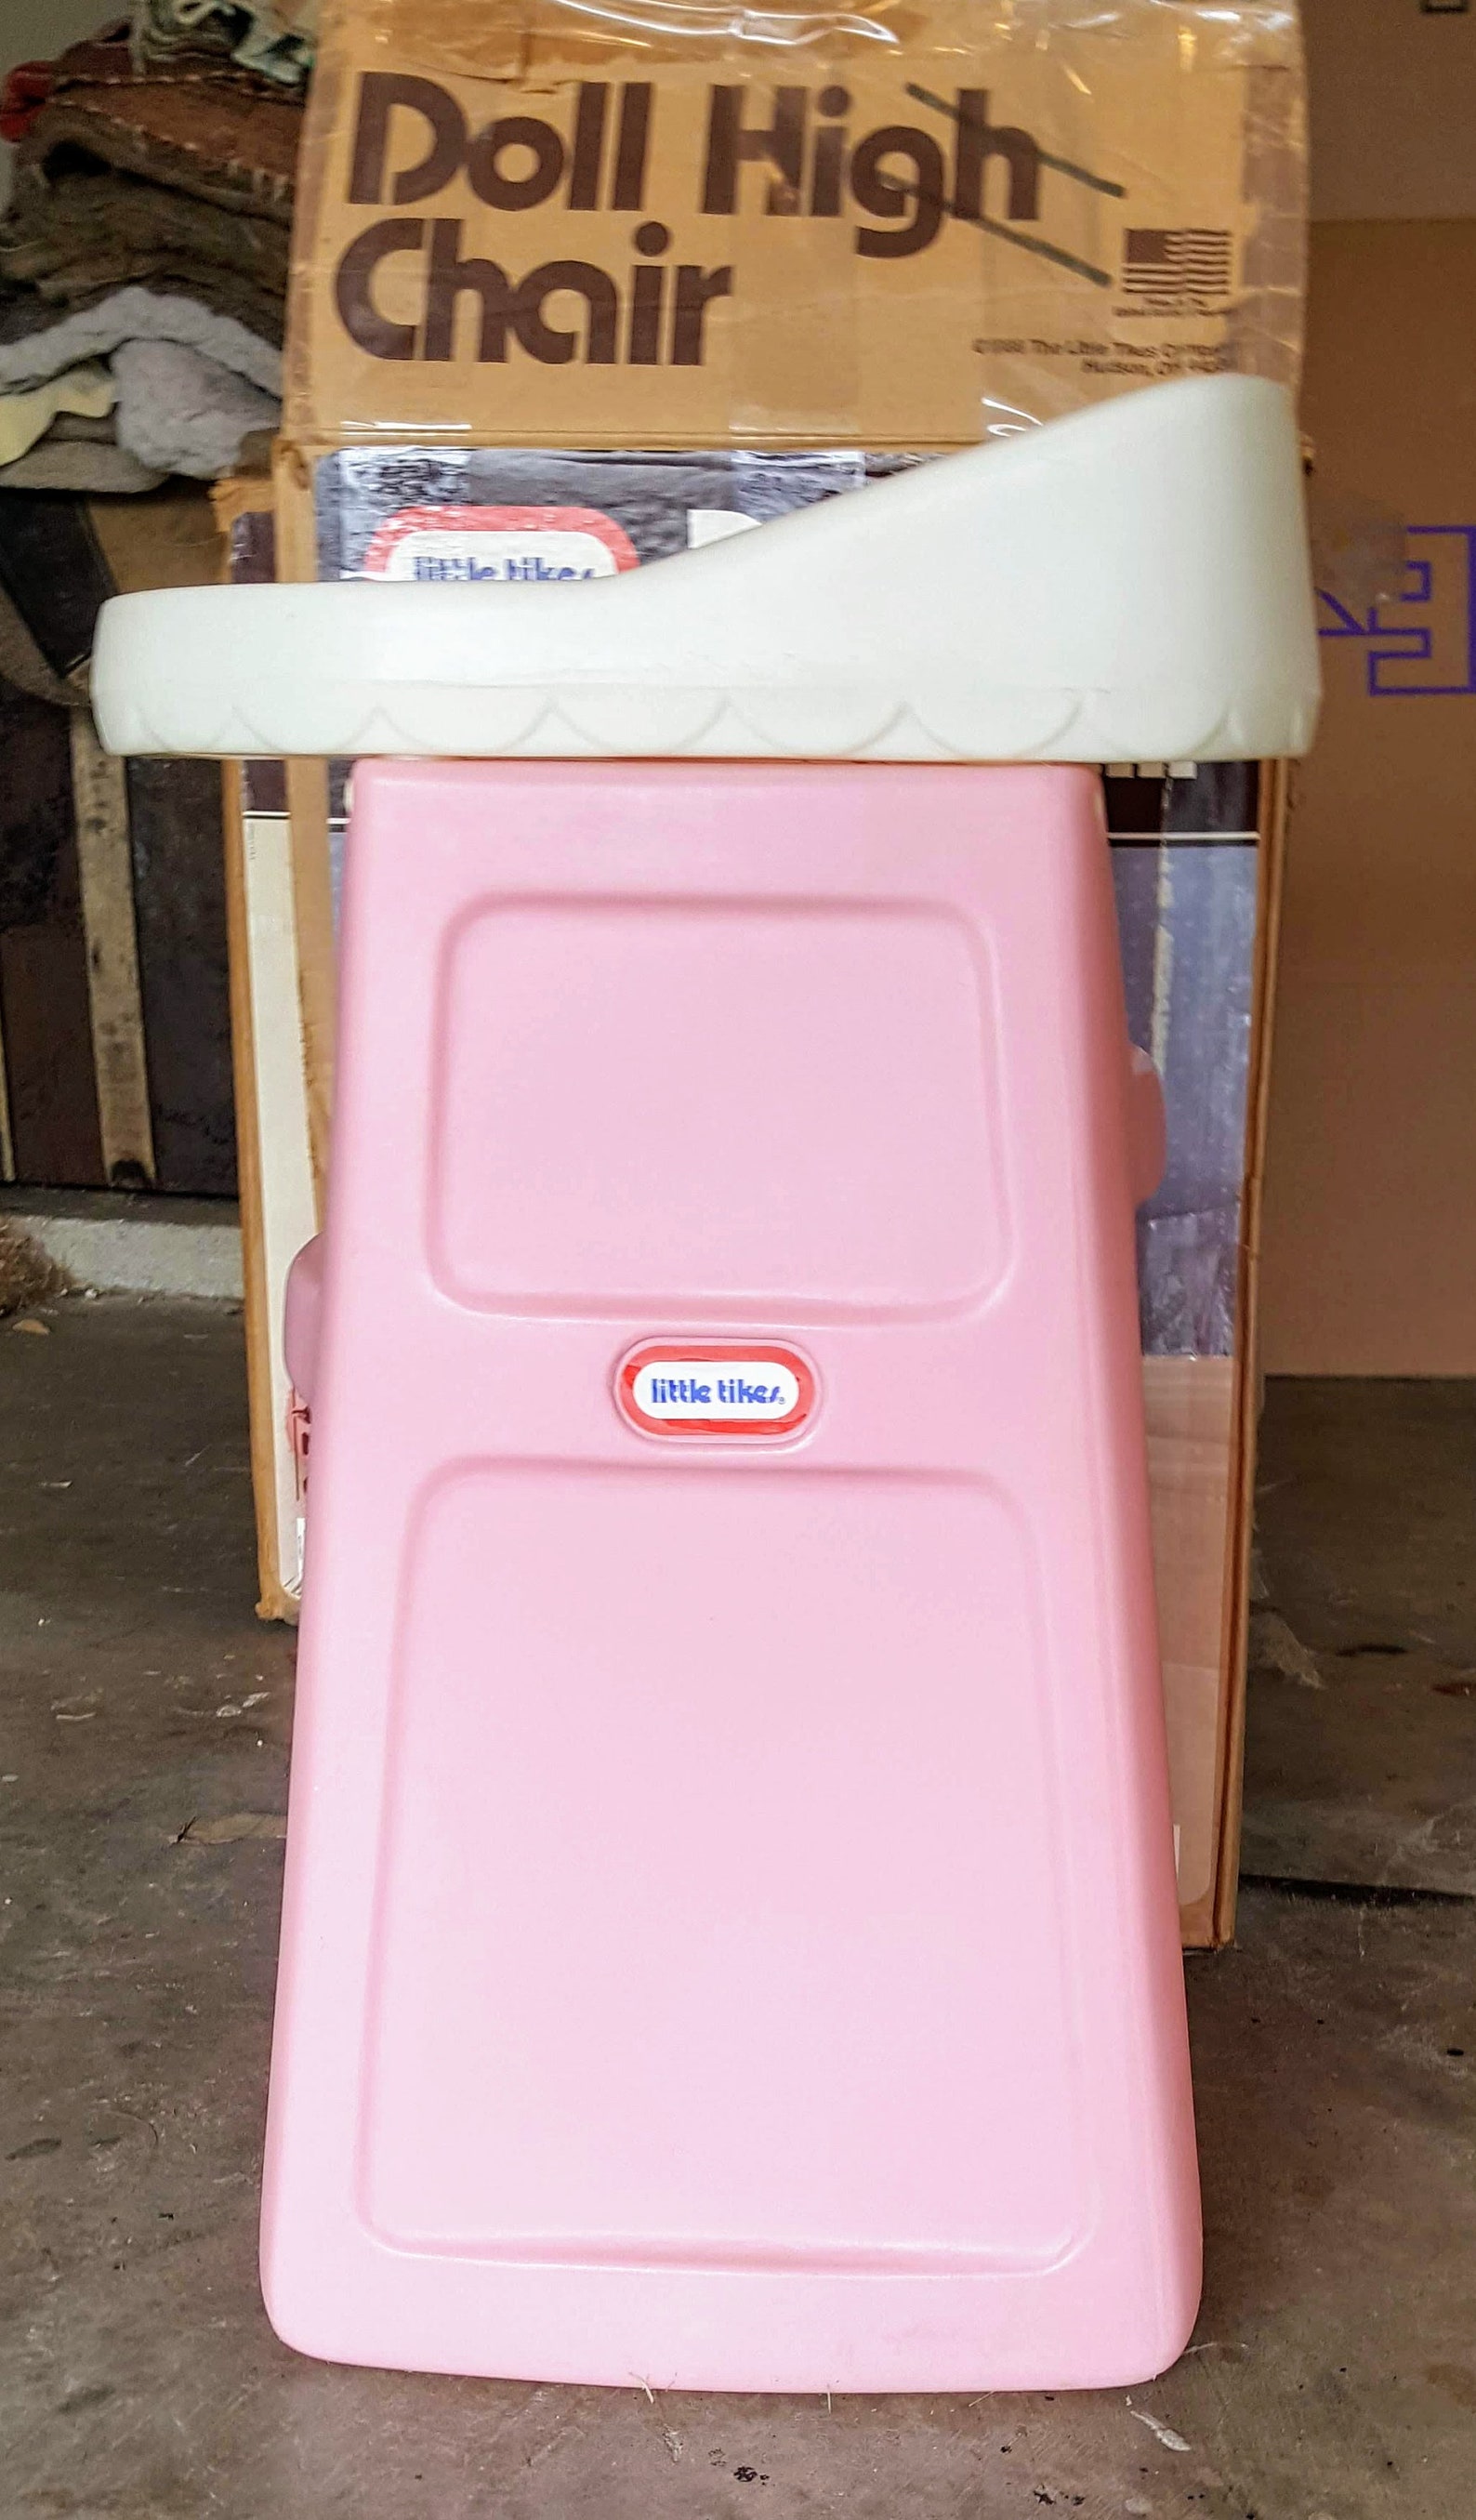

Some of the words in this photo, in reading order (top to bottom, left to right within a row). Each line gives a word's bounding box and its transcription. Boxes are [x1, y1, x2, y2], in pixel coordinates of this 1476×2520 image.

[345, 71, 653, 211] Doll
[701, 84, 1040, 258] High
[336, 218, 732, 366] Chair
[651, 1379, 712, 1404] little
